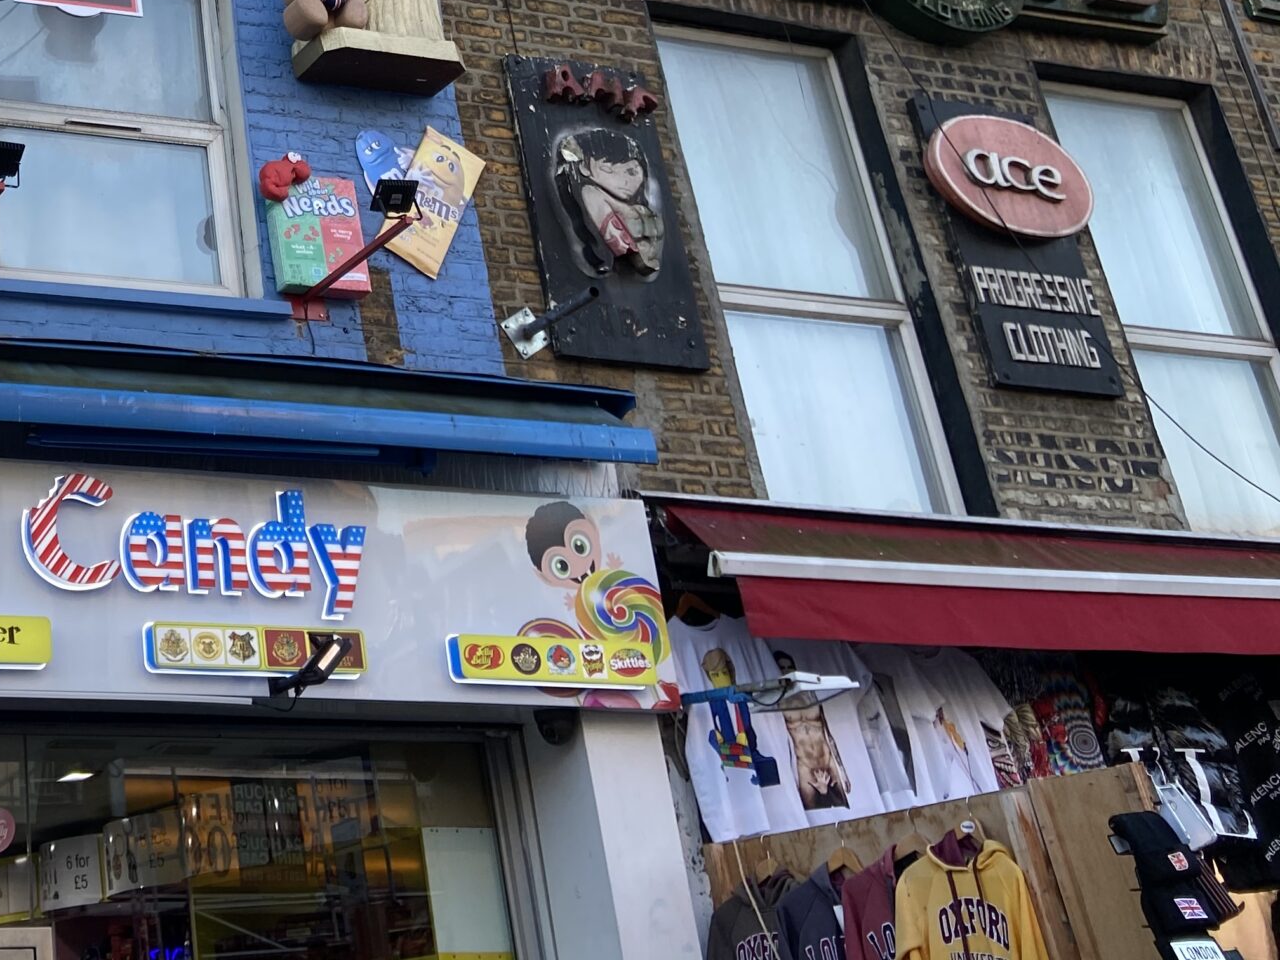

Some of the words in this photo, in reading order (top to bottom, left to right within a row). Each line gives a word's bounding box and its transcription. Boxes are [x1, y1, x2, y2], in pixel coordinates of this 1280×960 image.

[964, 148, 1067, 203] ace
[971, 265, 1101, 317] PROGRESSIVE
[1002, 321, 1101, 369] CLOTHING
[20, 473, 366, 620] Candy
[609, 657, 651, 672] Skittles
[66, 855, 73, 871] 6
[75, 854, 91, 869] for
[74, 874, 88, 890] £5
[938, 896, 1010, 952] OXFORD
